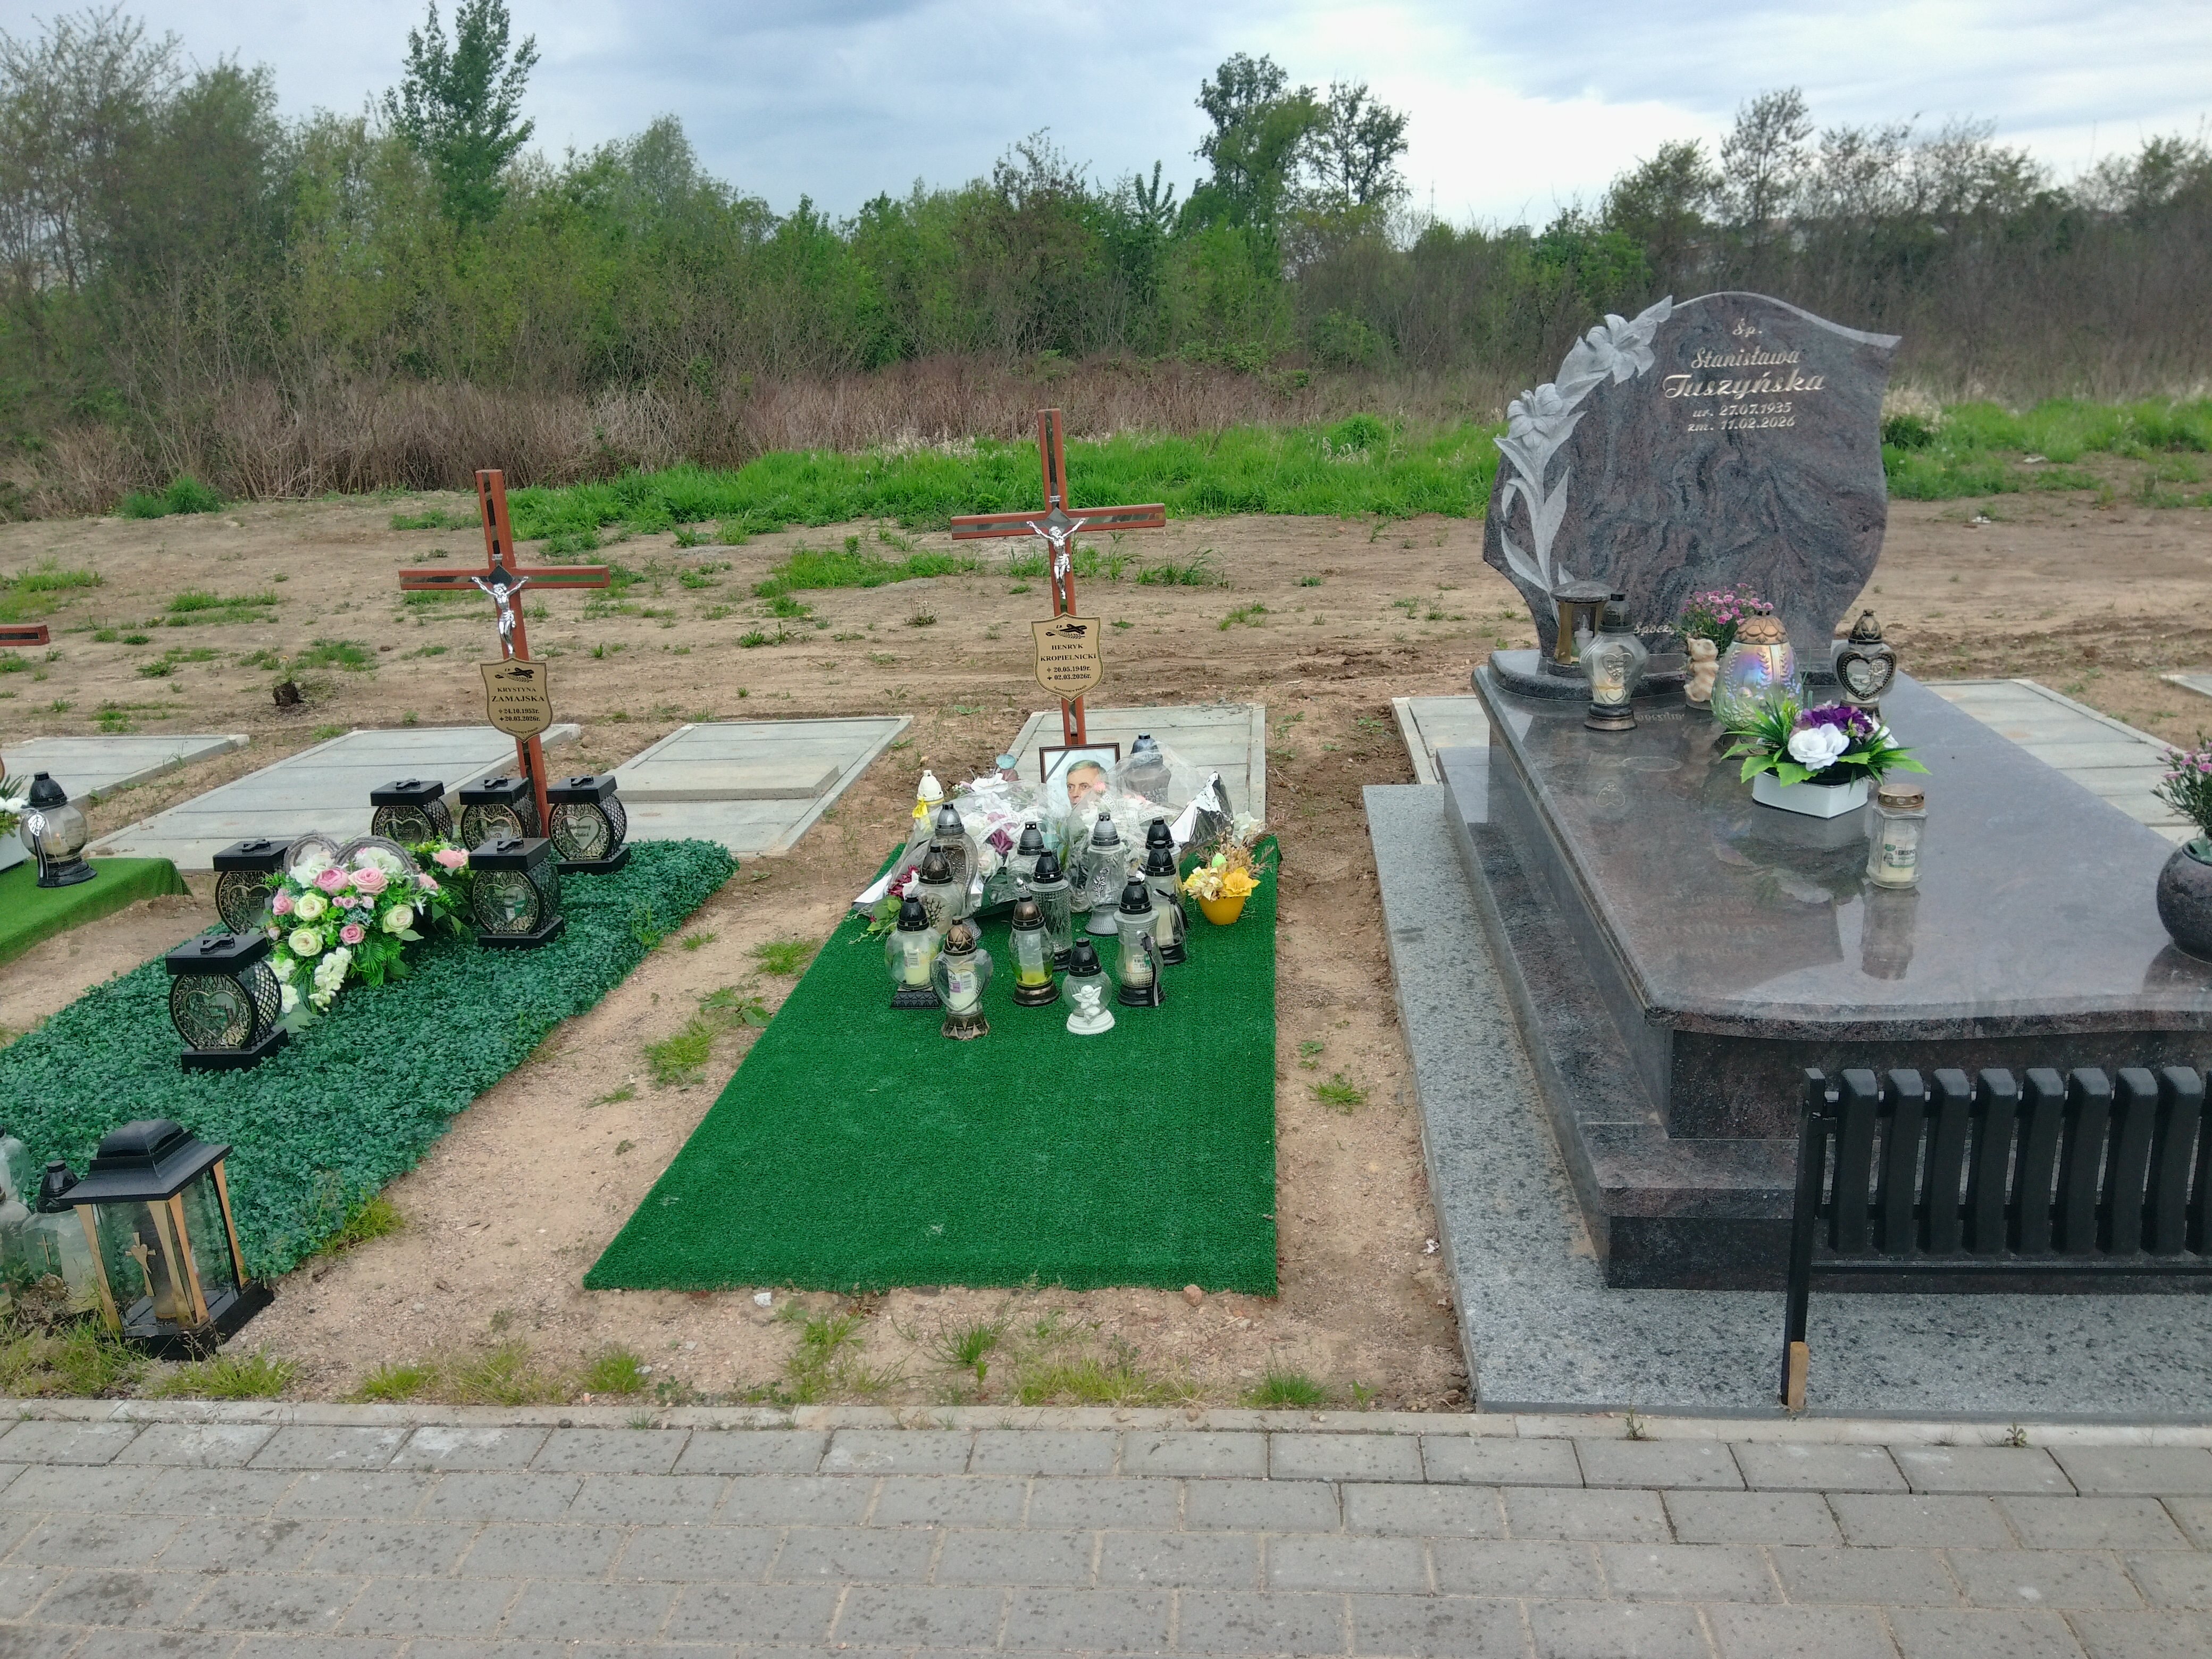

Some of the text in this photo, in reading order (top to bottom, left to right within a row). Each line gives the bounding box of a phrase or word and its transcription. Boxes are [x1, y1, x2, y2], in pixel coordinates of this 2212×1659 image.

[1690, 345, 1800, 369] Stanisława
[1662, 368, 1826, 400] Tuszyńska
[1692, 401, 1792, 418] ur. 27.07.1935
[1688, 415, 1796, 432] zm. 11.02.2026
